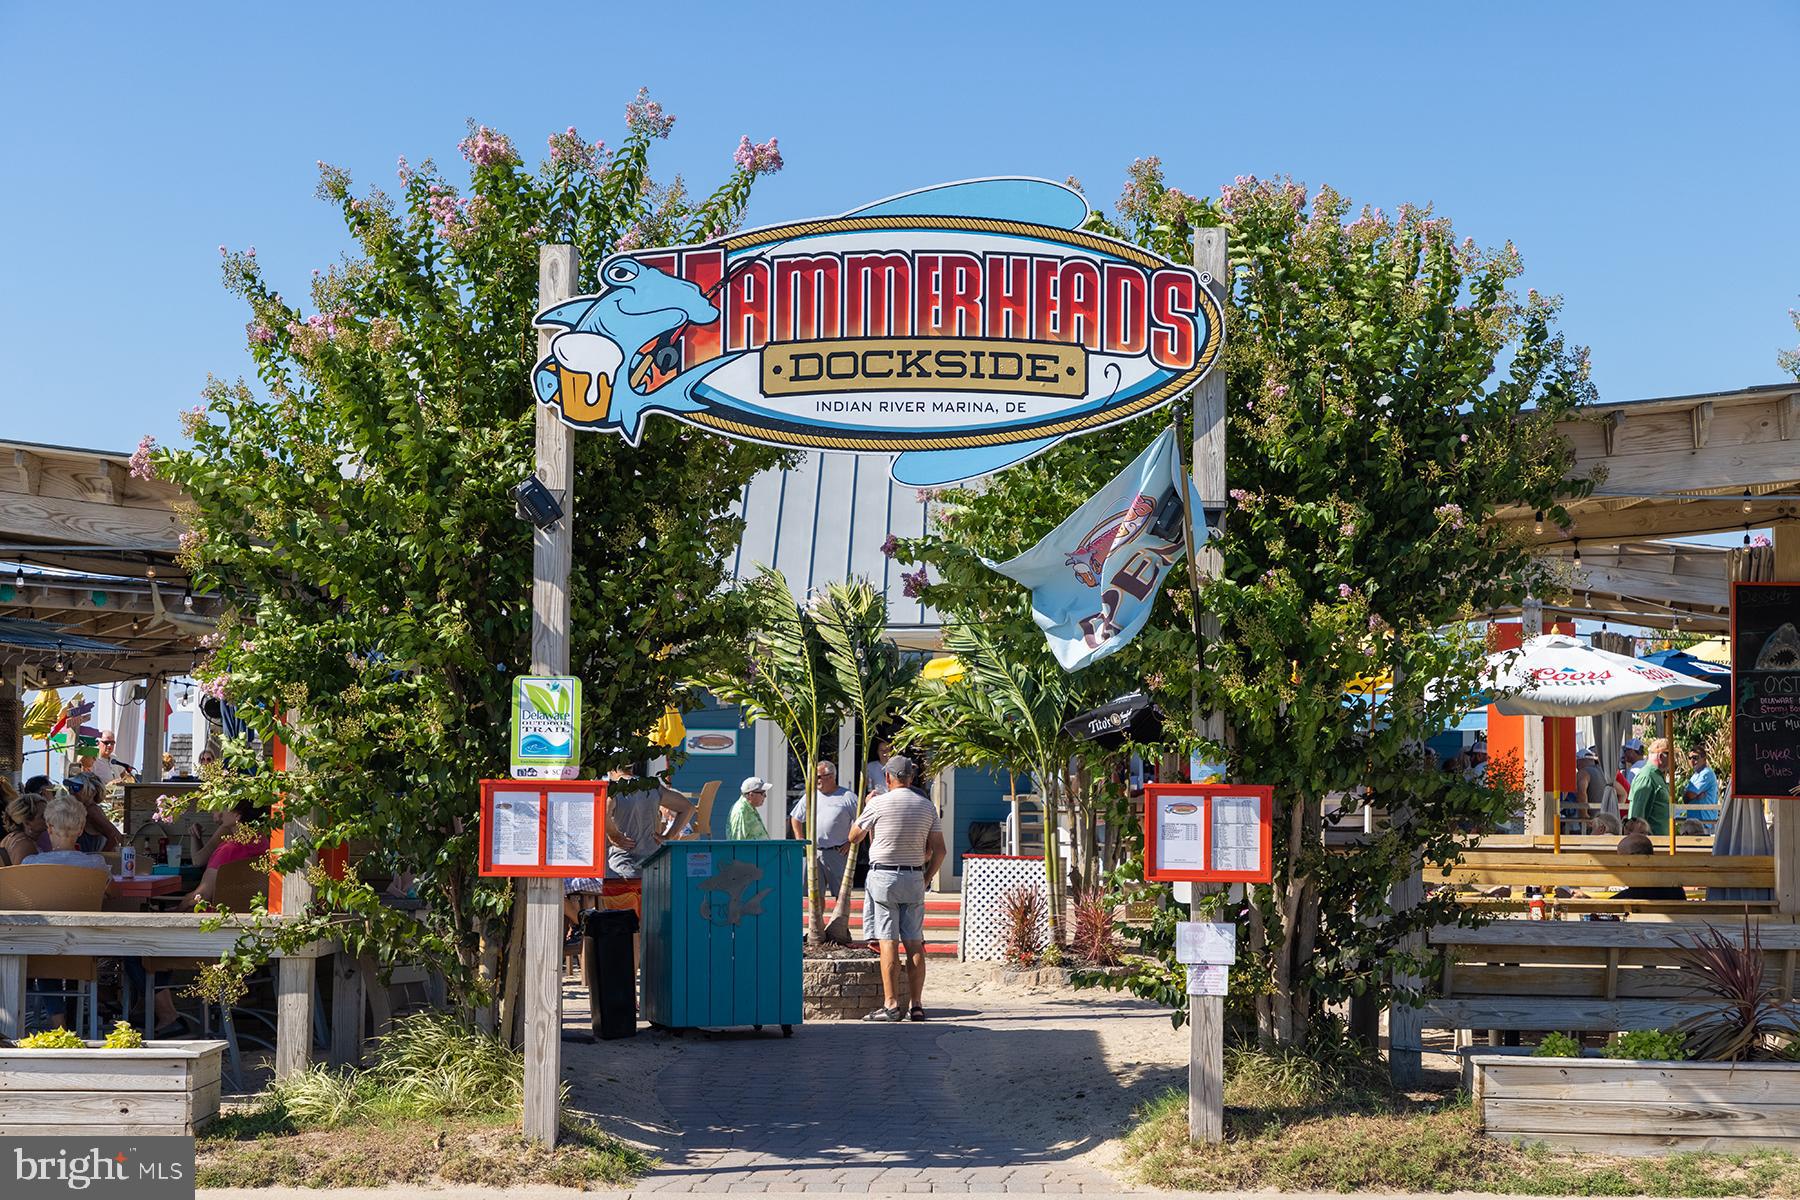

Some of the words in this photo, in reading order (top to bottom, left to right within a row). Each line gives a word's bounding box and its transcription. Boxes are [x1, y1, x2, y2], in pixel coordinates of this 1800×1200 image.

[789, 350, 1060, 383] DOCKSIDE
[816, 401, 876, 413] INDIAN
[879, 401, 925, 413] RIVER
[932, 401, 999, 415] MARINA,
[1006, 402, 1026, 413] DE
[1529, 667, 1614, 681] Coors
[522, 709, 570, 720] Delaware
[1753, 721, 1776, 732] LIVE
